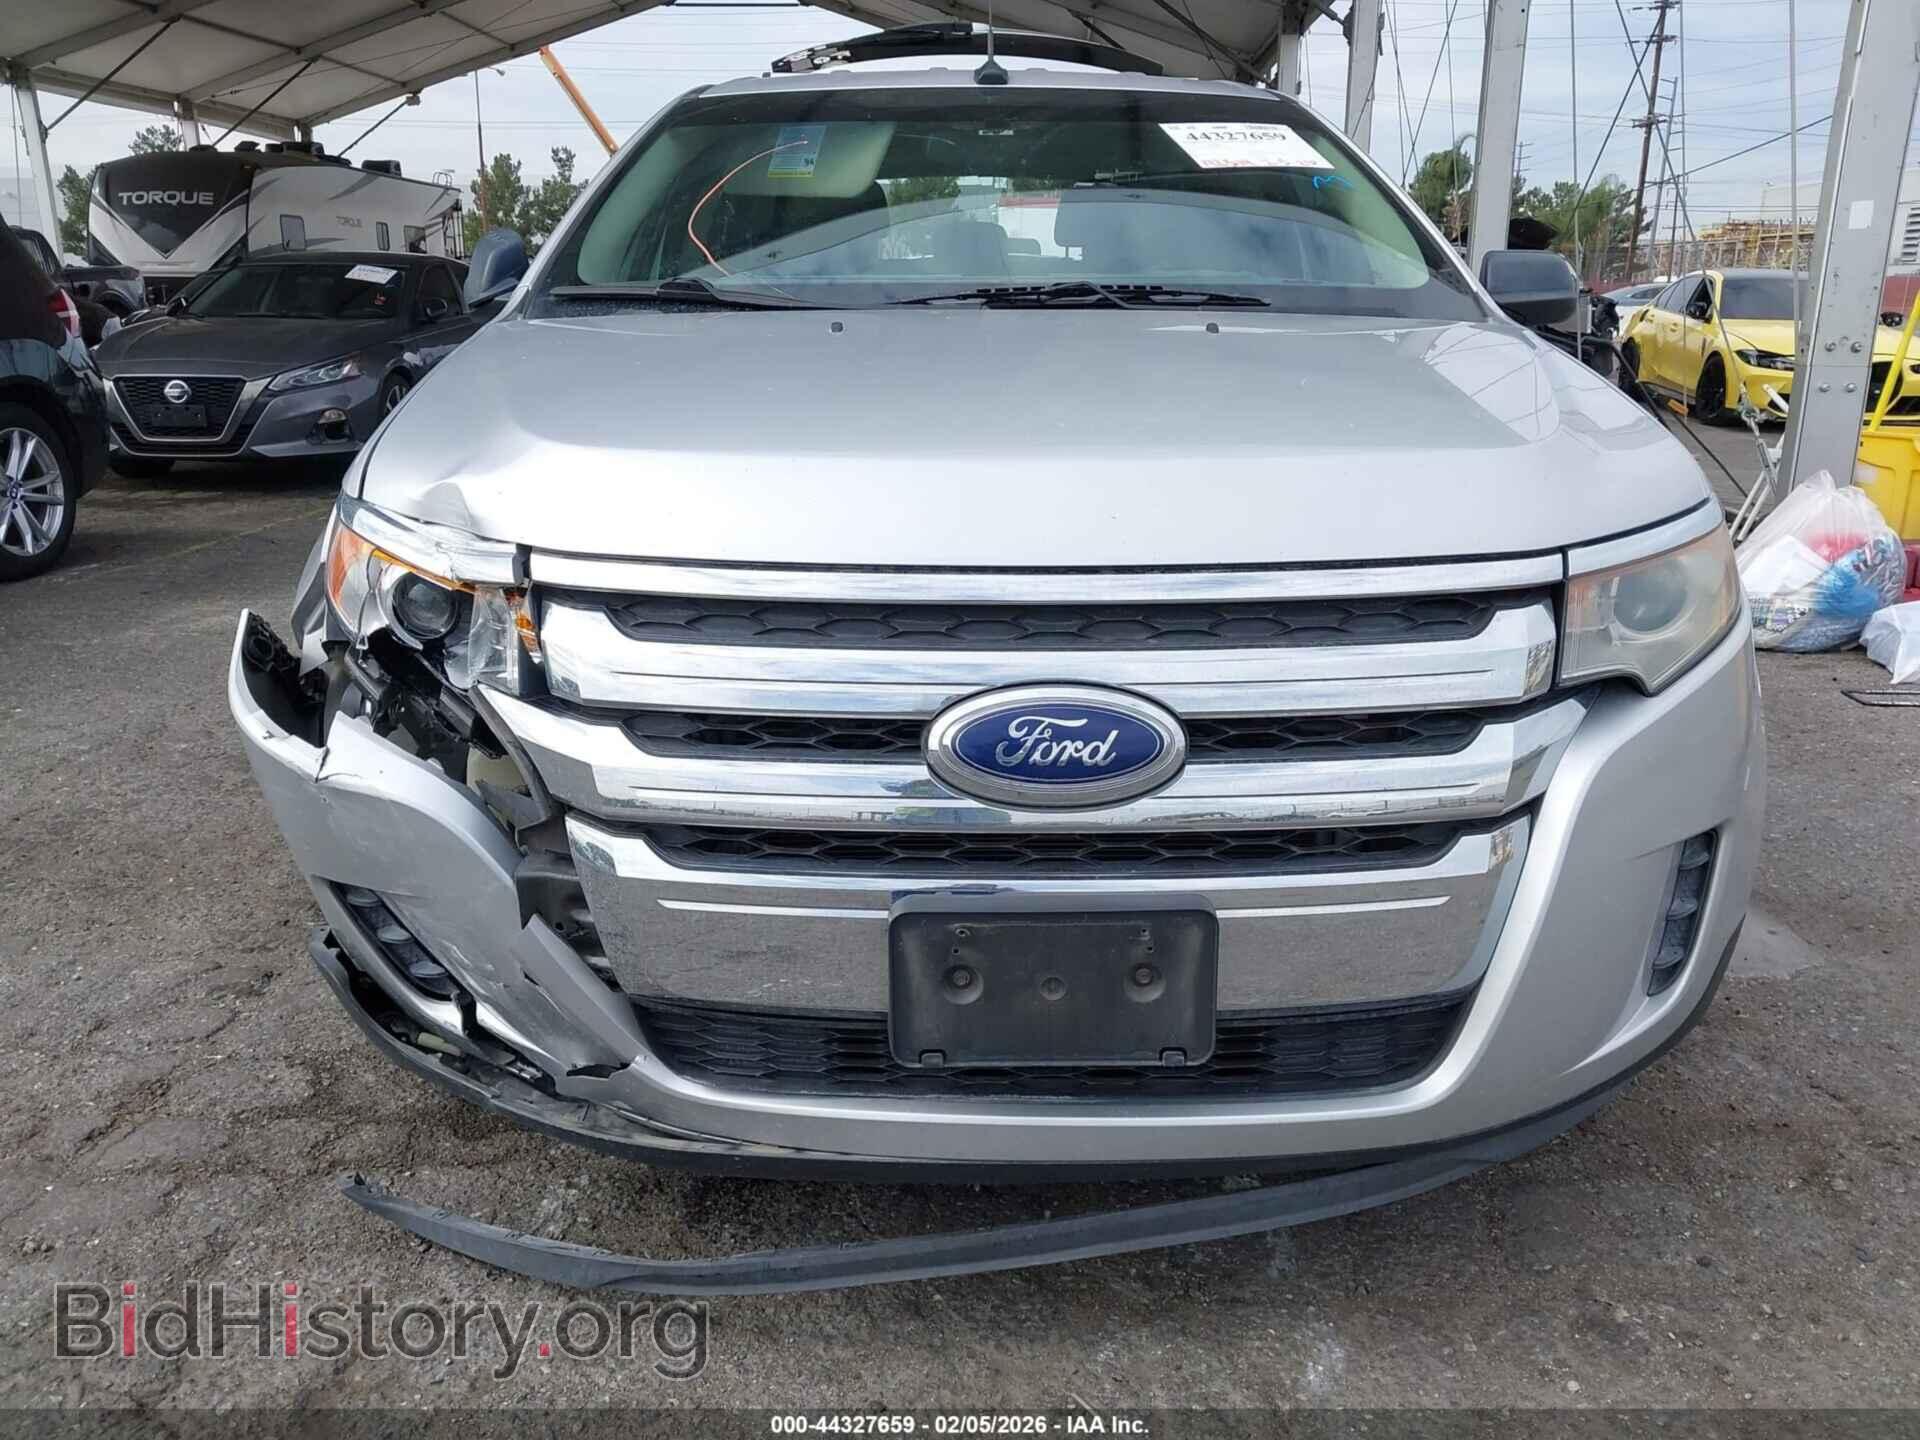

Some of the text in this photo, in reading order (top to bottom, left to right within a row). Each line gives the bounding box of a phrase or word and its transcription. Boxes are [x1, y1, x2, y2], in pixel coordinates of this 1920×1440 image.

[1186, 131, 1287, 142] 44327659
[118, 190, 214, 206] TORQUE
[995, 715, 1120, 767] Ford
